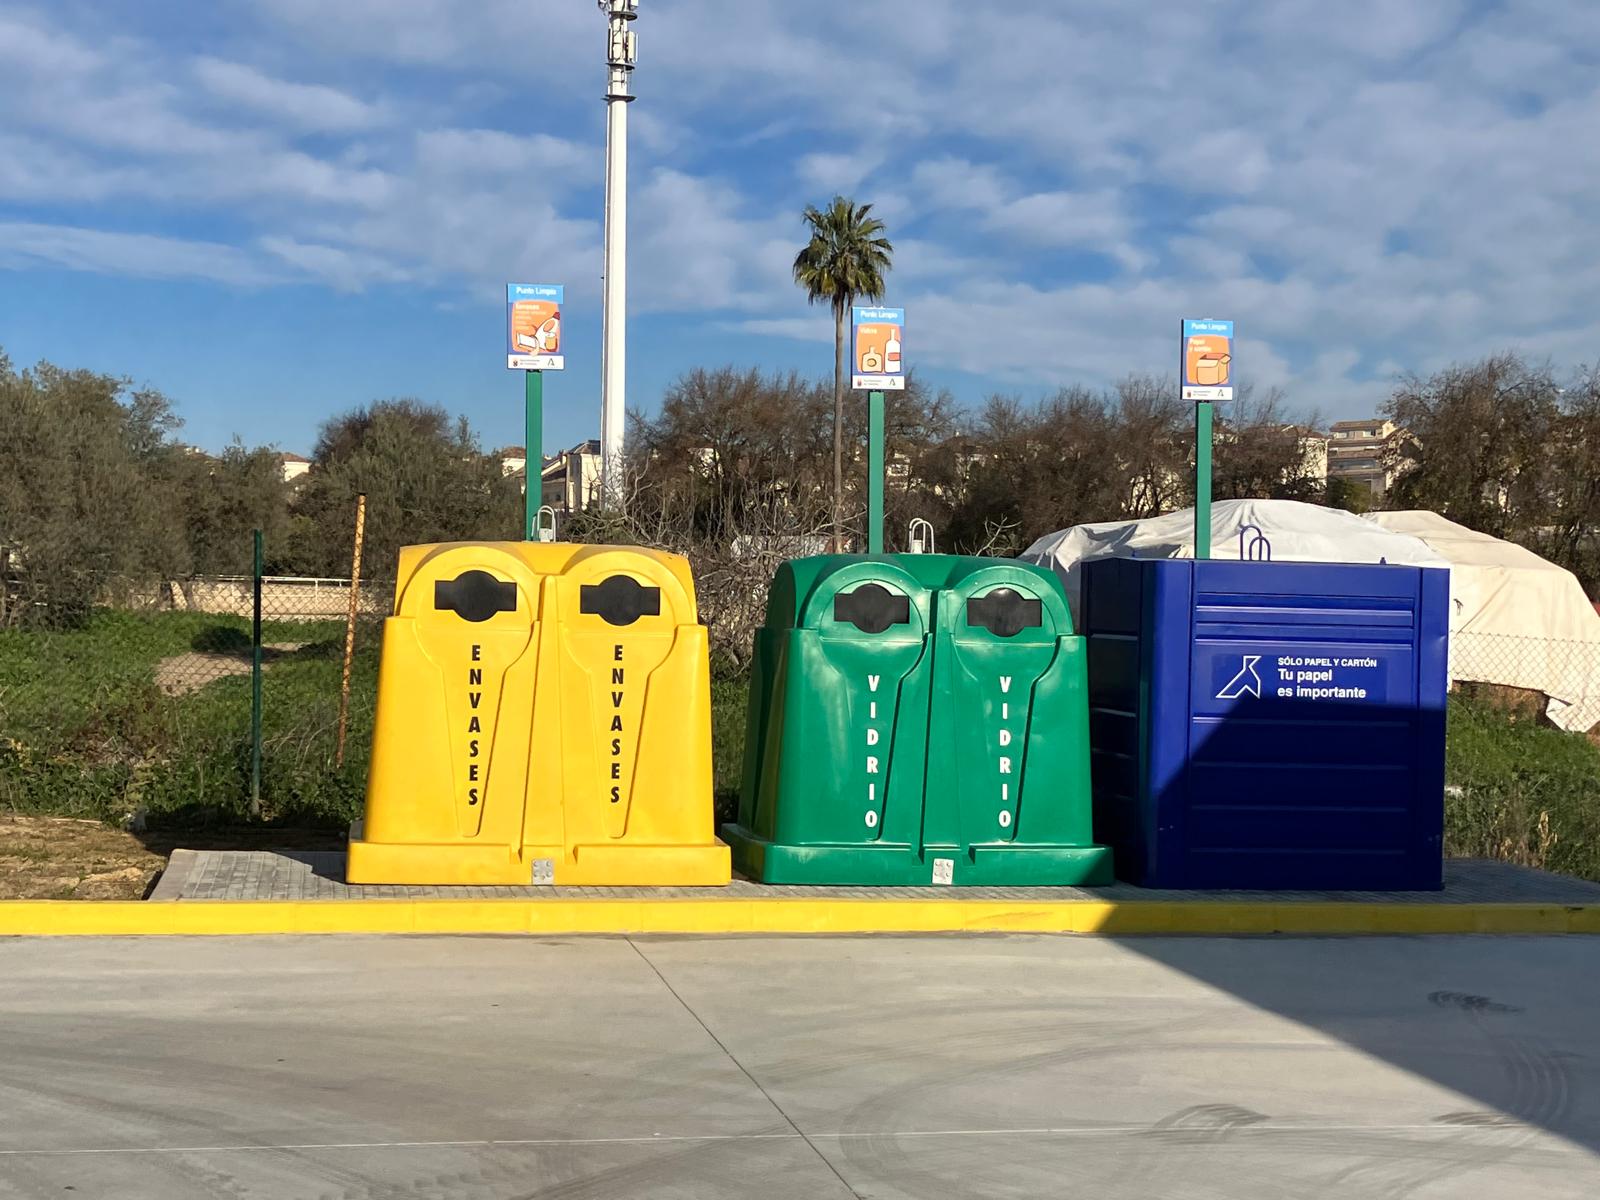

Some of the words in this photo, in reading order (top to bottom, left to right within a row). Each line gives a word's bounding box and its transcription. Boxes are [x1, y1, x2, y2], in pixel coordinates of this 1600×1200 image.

[516, 286, 534, 294] Punto
[1277, 687, 1293, 697] es
[1297, 686, 1366, 700] importante
[1278, 656, 1304, 666] SÓLO
[1305, 658, 1332, 667] PAPEL
[1333, 658, 1339, 667] Y
[1341, 657, 1377, 667] CARTÓN
[1278, 668, 1293, 680] Tu
[1297, 669, 1332, 683] papel
[468, 644, 482, 806] ENVASES
[610, 644, 624, 804] ENVASES
[864, 674, 880, 828] VIDRIO
[998, 676, 1012, 828] VIDRIO
